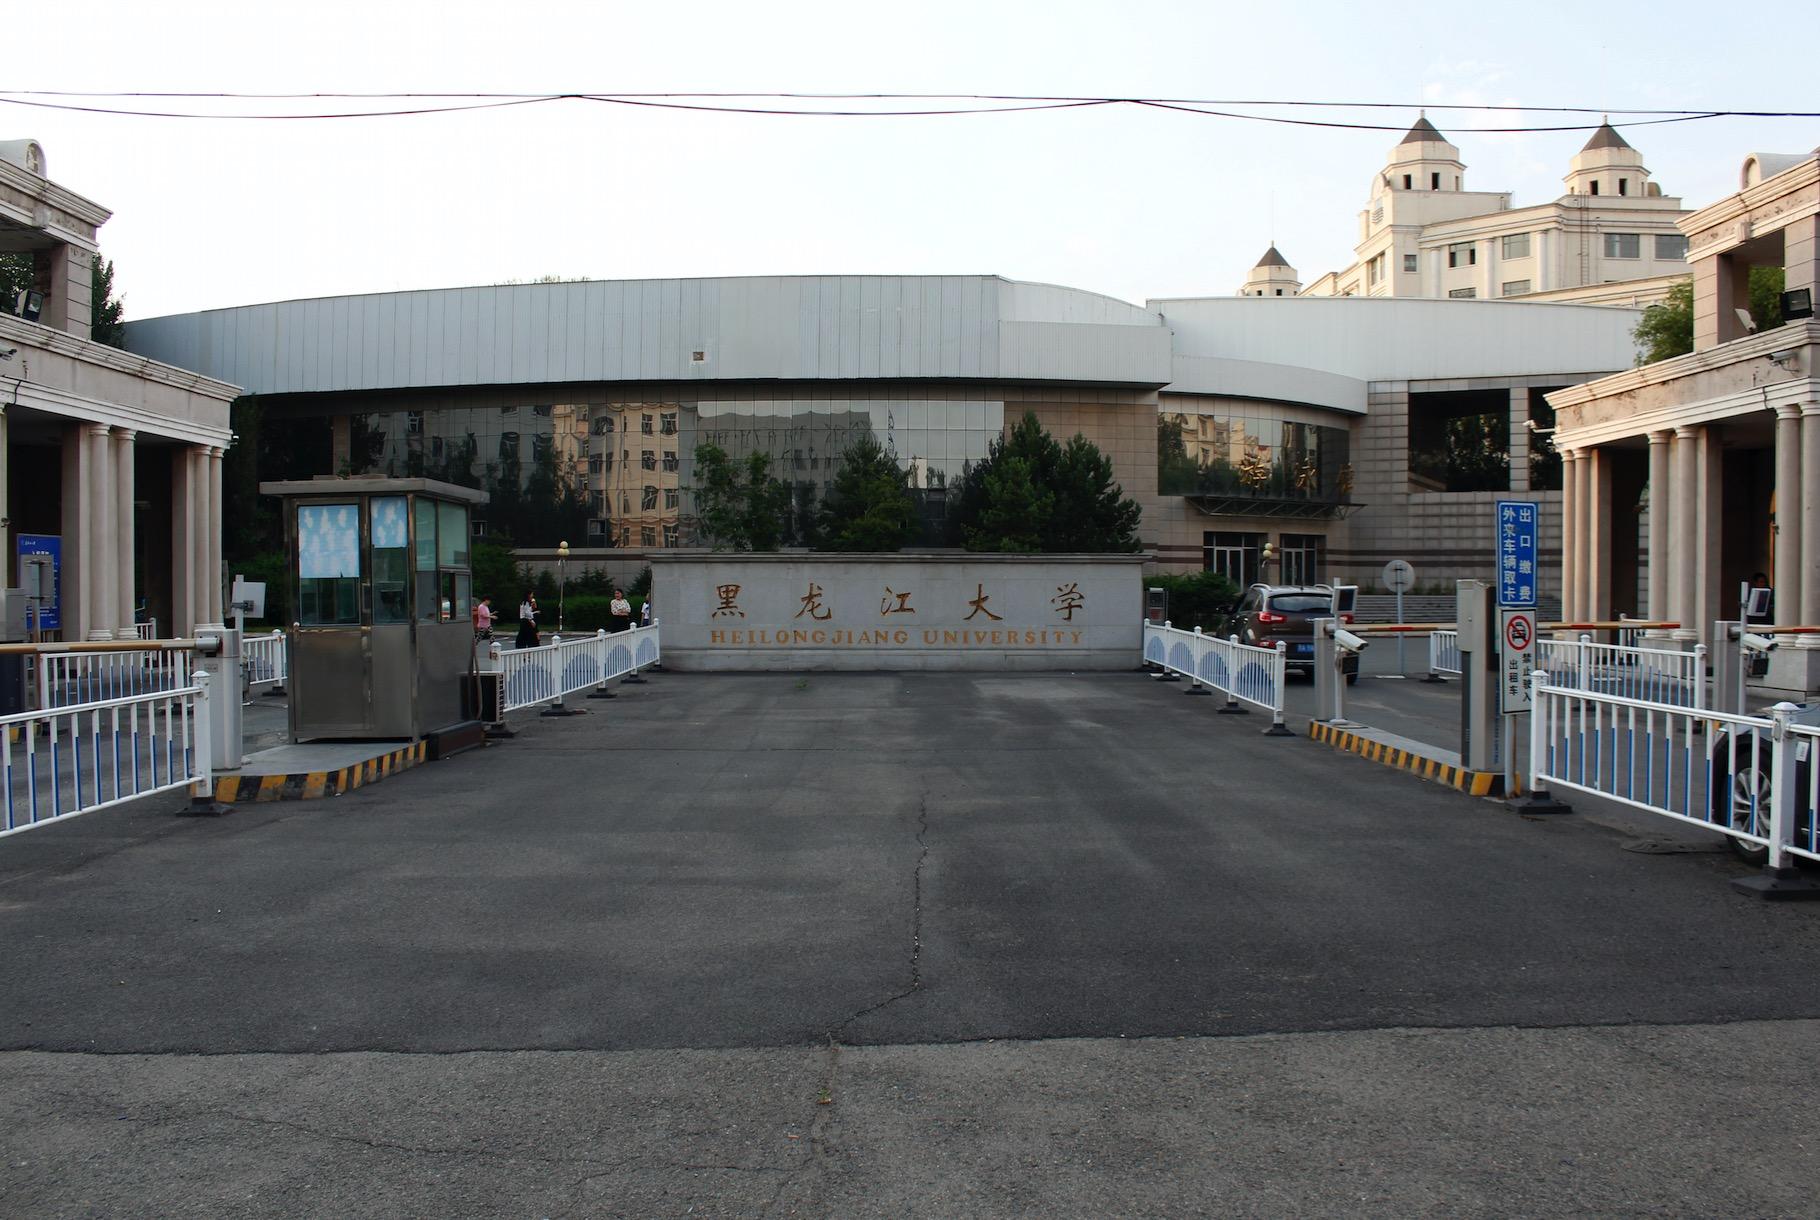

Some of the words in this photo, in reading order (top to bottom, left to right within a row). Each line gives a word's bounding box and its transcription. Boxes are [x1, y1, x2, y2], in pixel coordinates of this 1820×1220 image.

[1502, 506, 1517, 601] 外来车辆取卡
[1519, 507, 1532, 601] 出口缴费
[711, 583, 1085, 622] 黑龙江大学
[710, 630, 909, 645] HEILONGJIANG
[923, 630, 1084, 645] UNIVERSITY
[1508, 659, 1519, 696] 出租车
[1521, 652, 1532, 703] 禁止驶入
